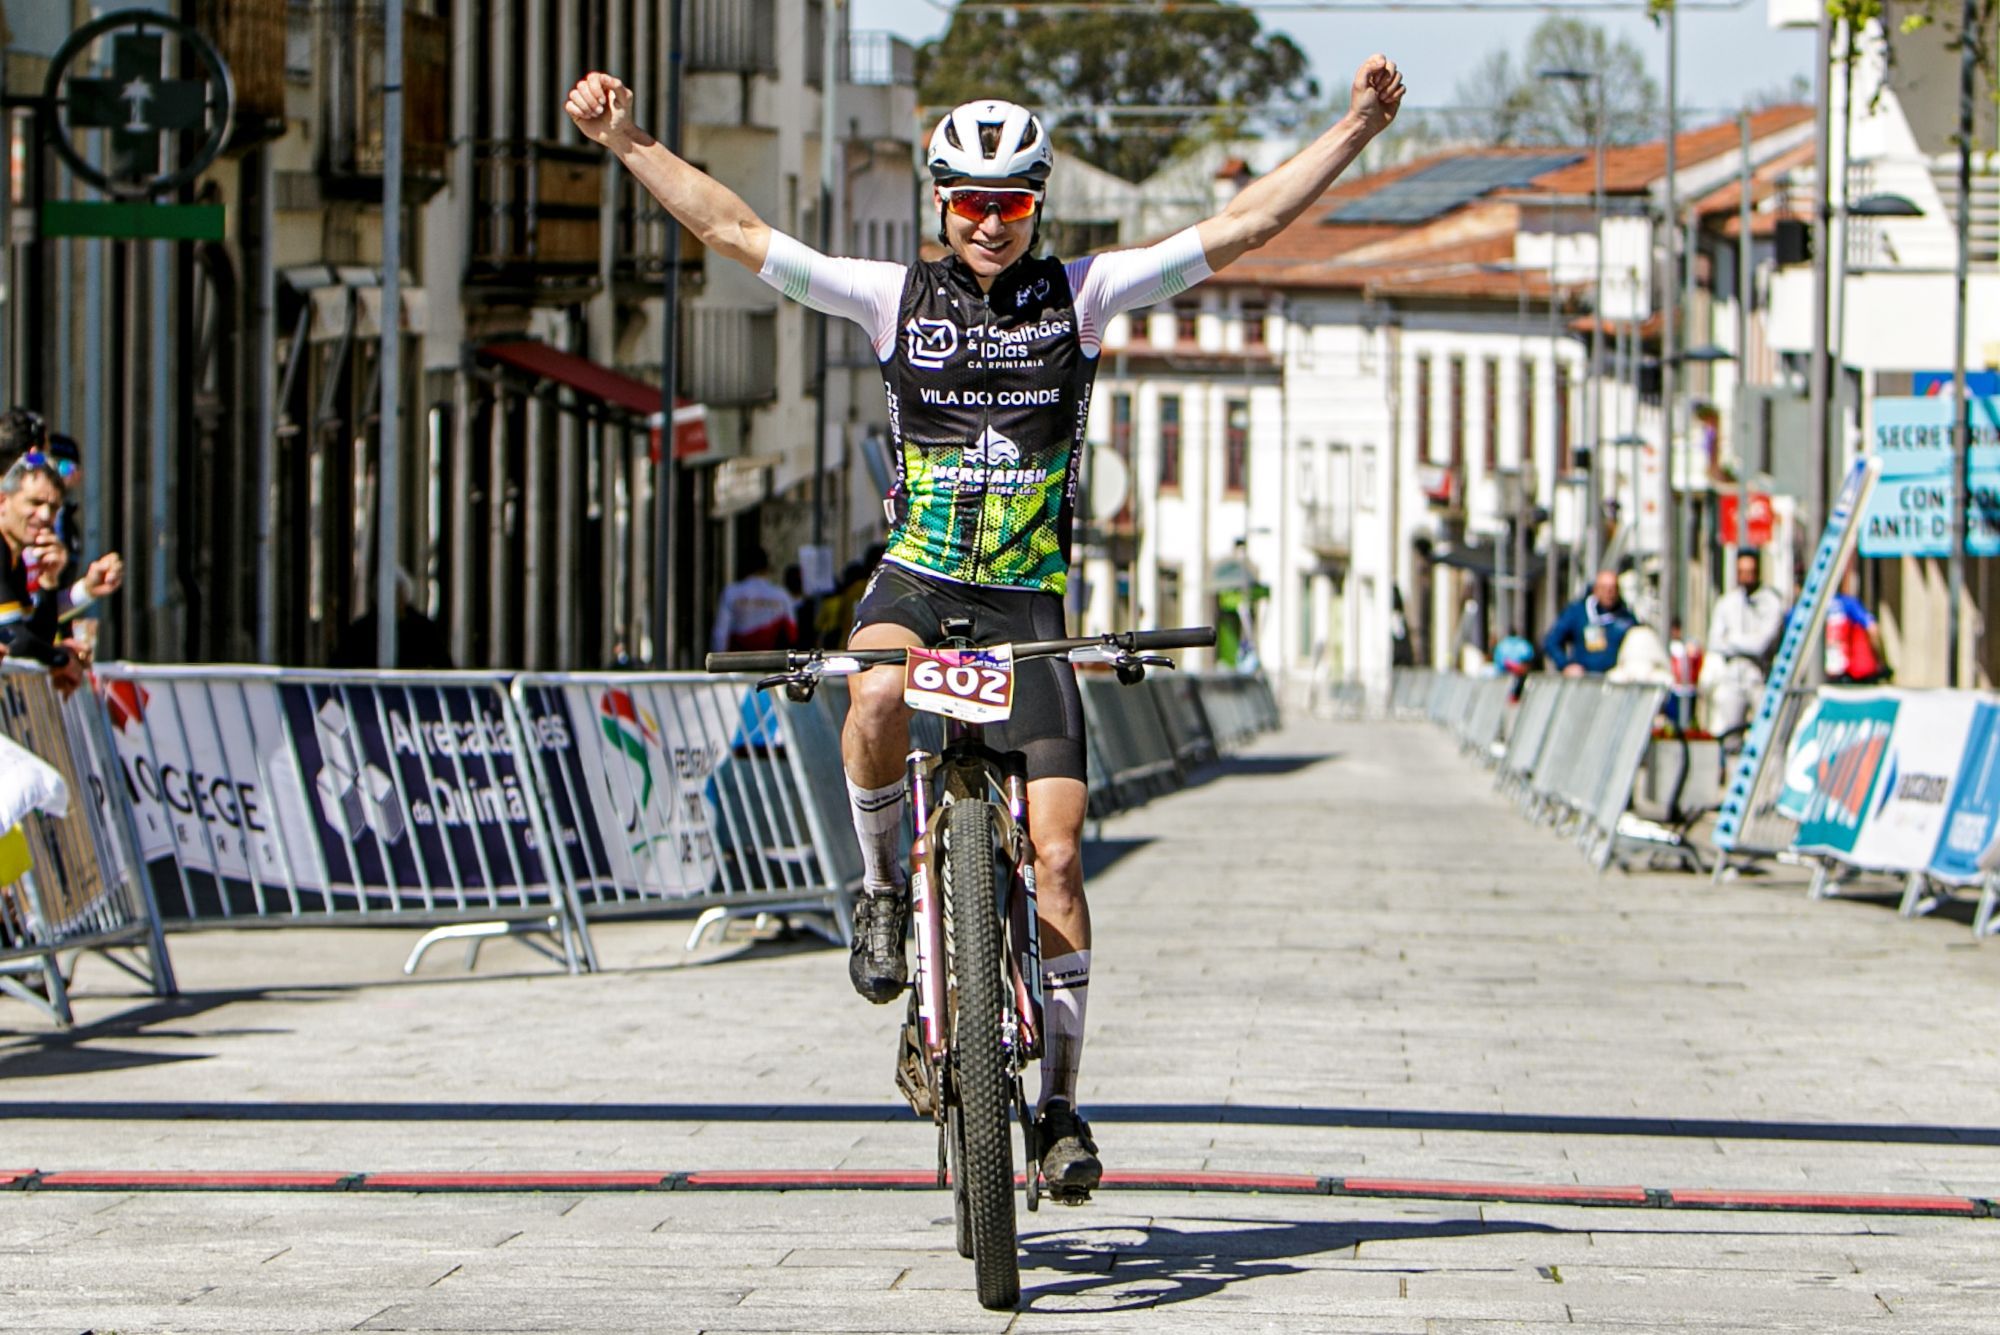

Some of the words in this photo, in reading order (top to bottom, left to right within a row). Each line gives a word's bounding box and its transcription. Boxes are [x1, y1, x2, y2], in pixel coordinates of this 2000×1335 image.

[967, 338, 978, 350] &
[967, 359, 1044, 369] CARPINTARIA
[920, 388, 959, 405] VILA
[963, 391, 993, 405] DO
[997, 388, 1060, 405] CONDE
[913, 660, 1007, 704] 602
[413, 799, 434, 824] da
